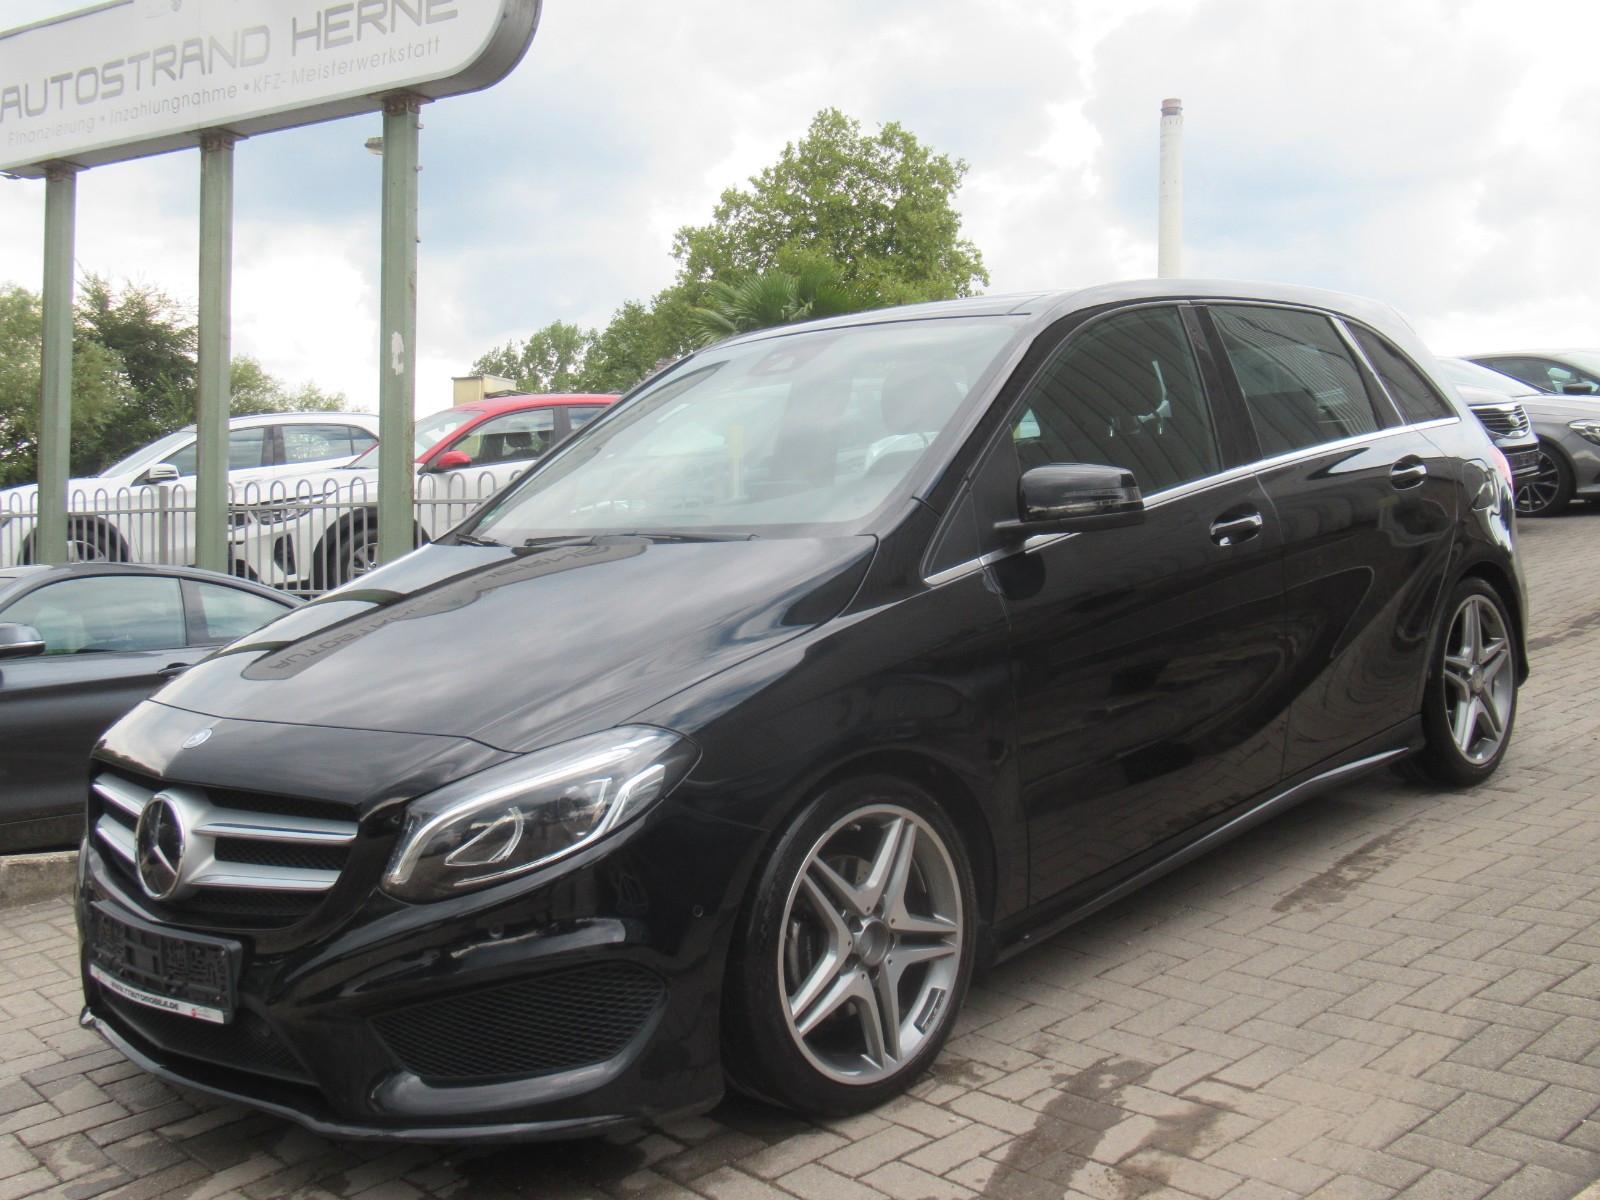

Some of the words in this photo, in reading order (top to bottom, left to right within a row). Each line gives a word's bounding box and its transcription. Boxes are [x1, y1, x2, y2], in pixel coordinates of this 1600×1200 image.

[0, 25, 271, 123] AUTOSTRAND
[291, 0, 459, 57] HERNE
[8, 115, 95, 146] Finanzierung
[110, 82, 237, 125] Inzahlungnahme
[292, 35, 440, 85] Meisterwerkstatt
